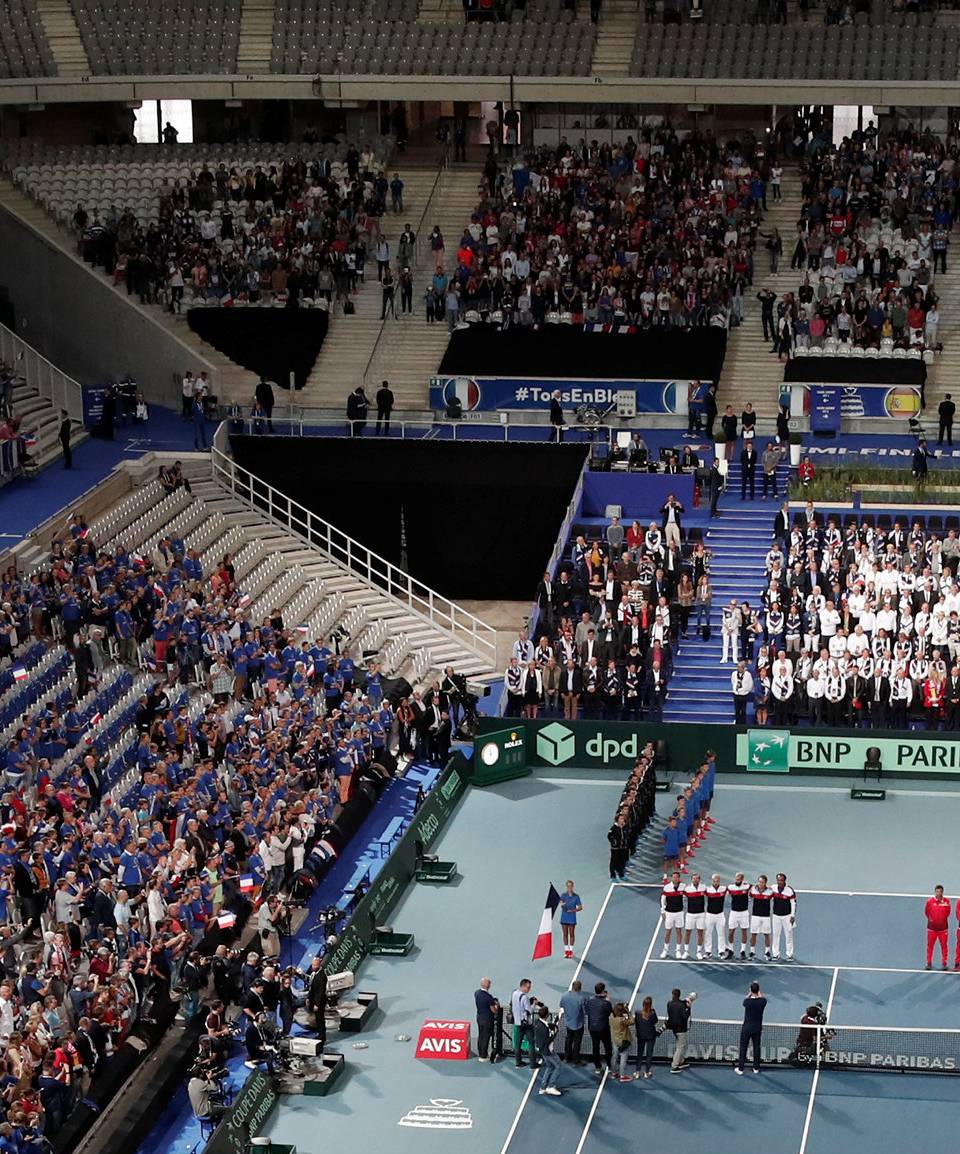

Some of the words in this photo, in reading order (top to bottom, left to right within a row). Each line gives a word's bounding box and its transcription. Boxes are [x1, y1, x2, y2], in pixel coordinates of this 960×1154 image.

[585, 732, 638, 763] dpd
[796, 741, 852, 764] BNP
[422, 1022, 466, 1030] AVIS
[419, 1038, 463, 1054] AVIS
[825, 1051, 868, 1064] BNP
[870, 1053, 957, 1070] PARIBAS
[231, 1093, 255, 1129] COUPE
[248, 1073, 267, 1103] DAVIS
[254, 1088, 277, 1124] PARIBAS
